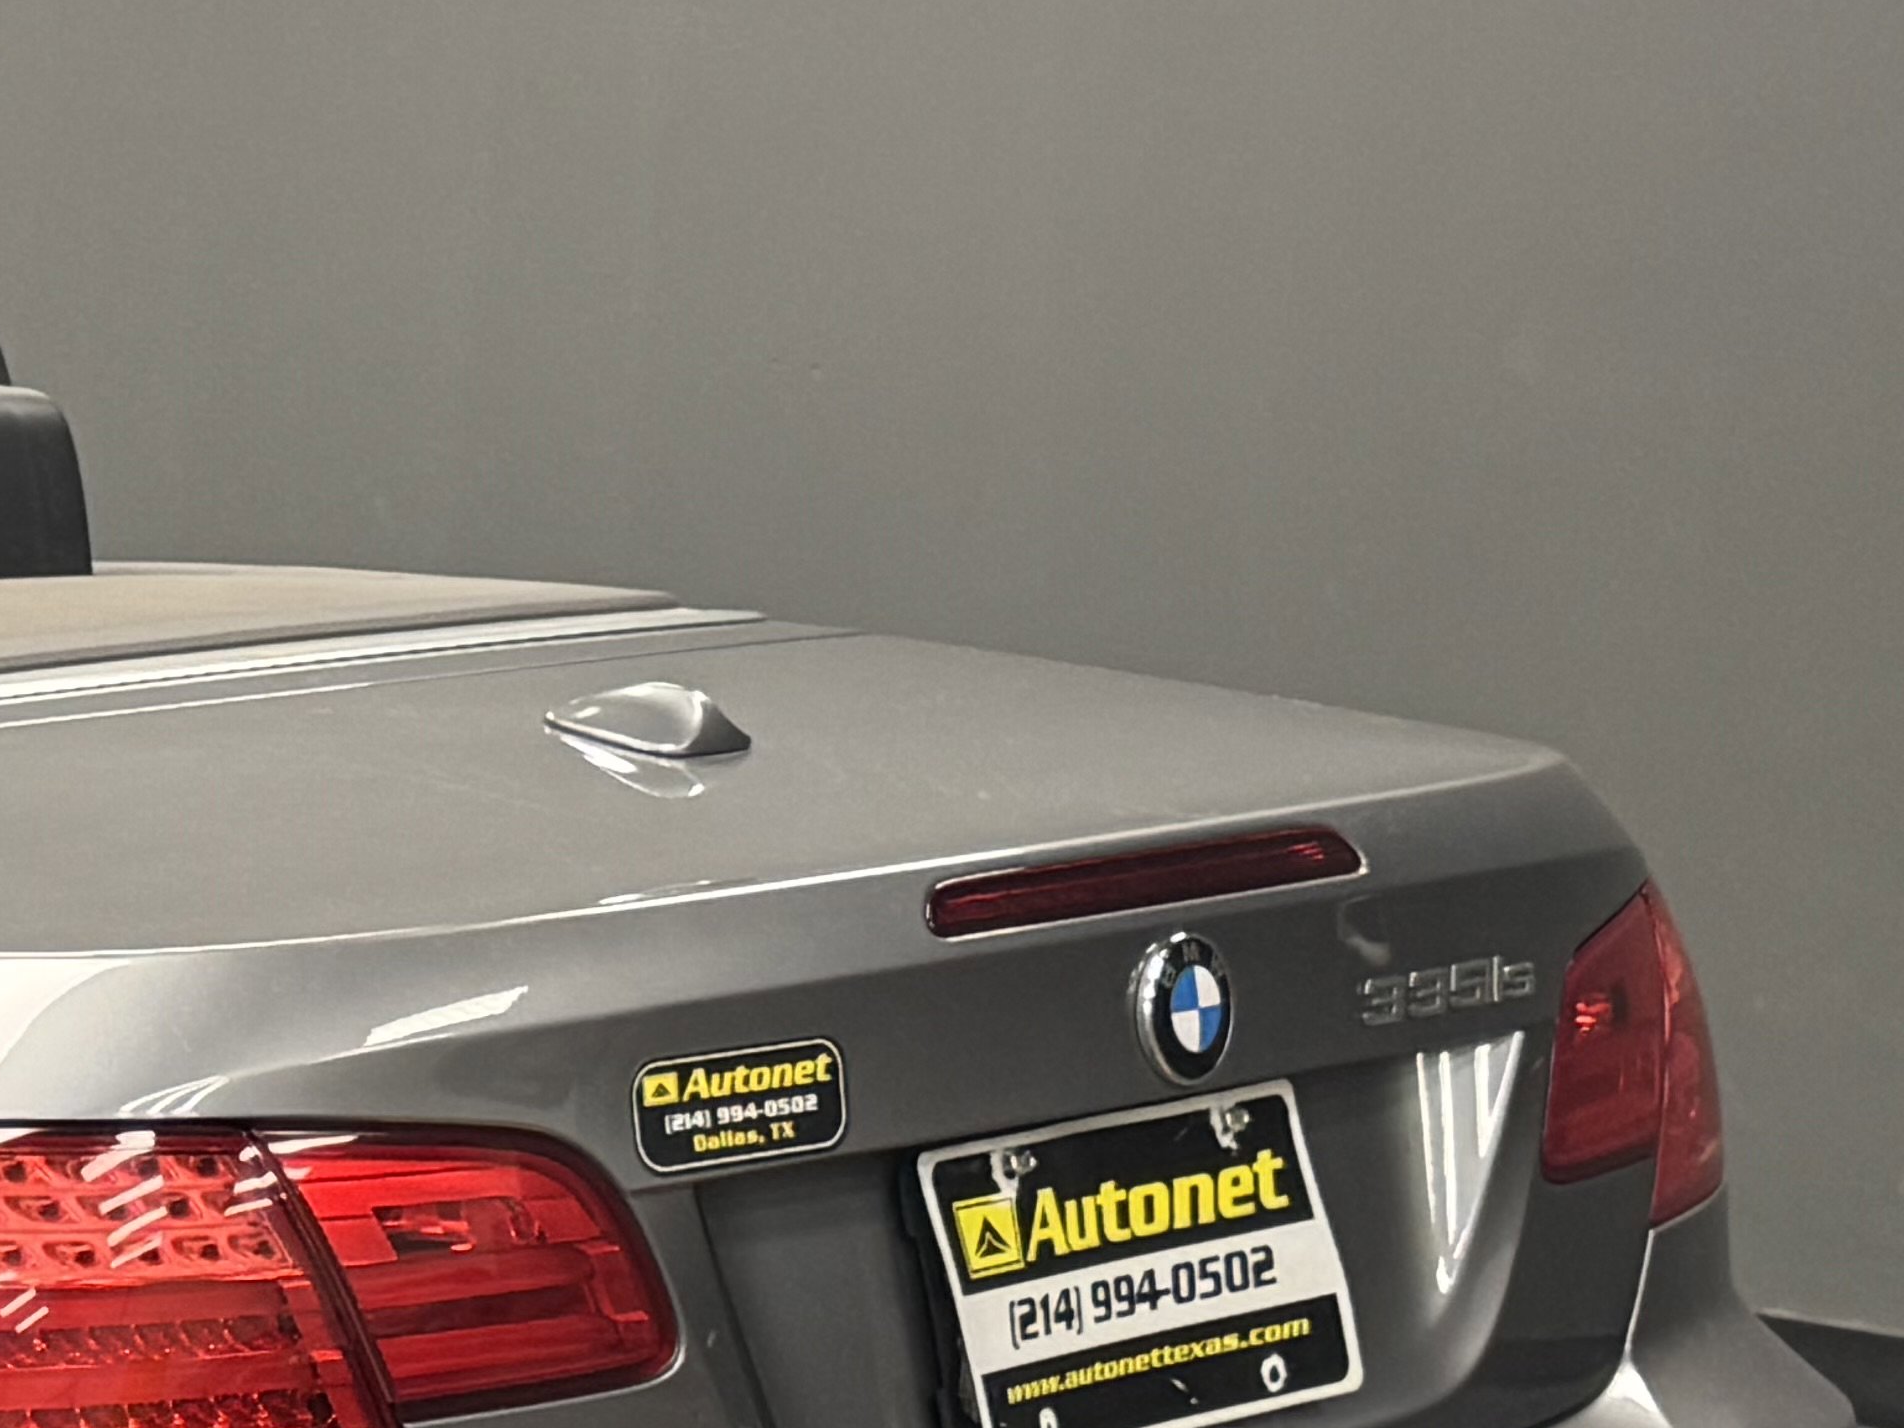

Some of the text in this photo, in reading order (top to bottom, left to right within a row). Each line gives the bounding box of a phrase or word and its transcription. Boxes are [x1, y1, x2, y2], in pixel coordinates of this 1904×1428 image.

[682, 1052, 833, 1102] Autonet
[665, 1093, 819, 1134] (214) 994-0502
[693, 1120, 797, 1152] Dallas, TX
[1027, 1148, 1290, 1262] Autonet
[1009, 1244, 1278, 1350] (214) 994-0502
[1007, 1317, 1312, 1404] www.autonettexas.com
